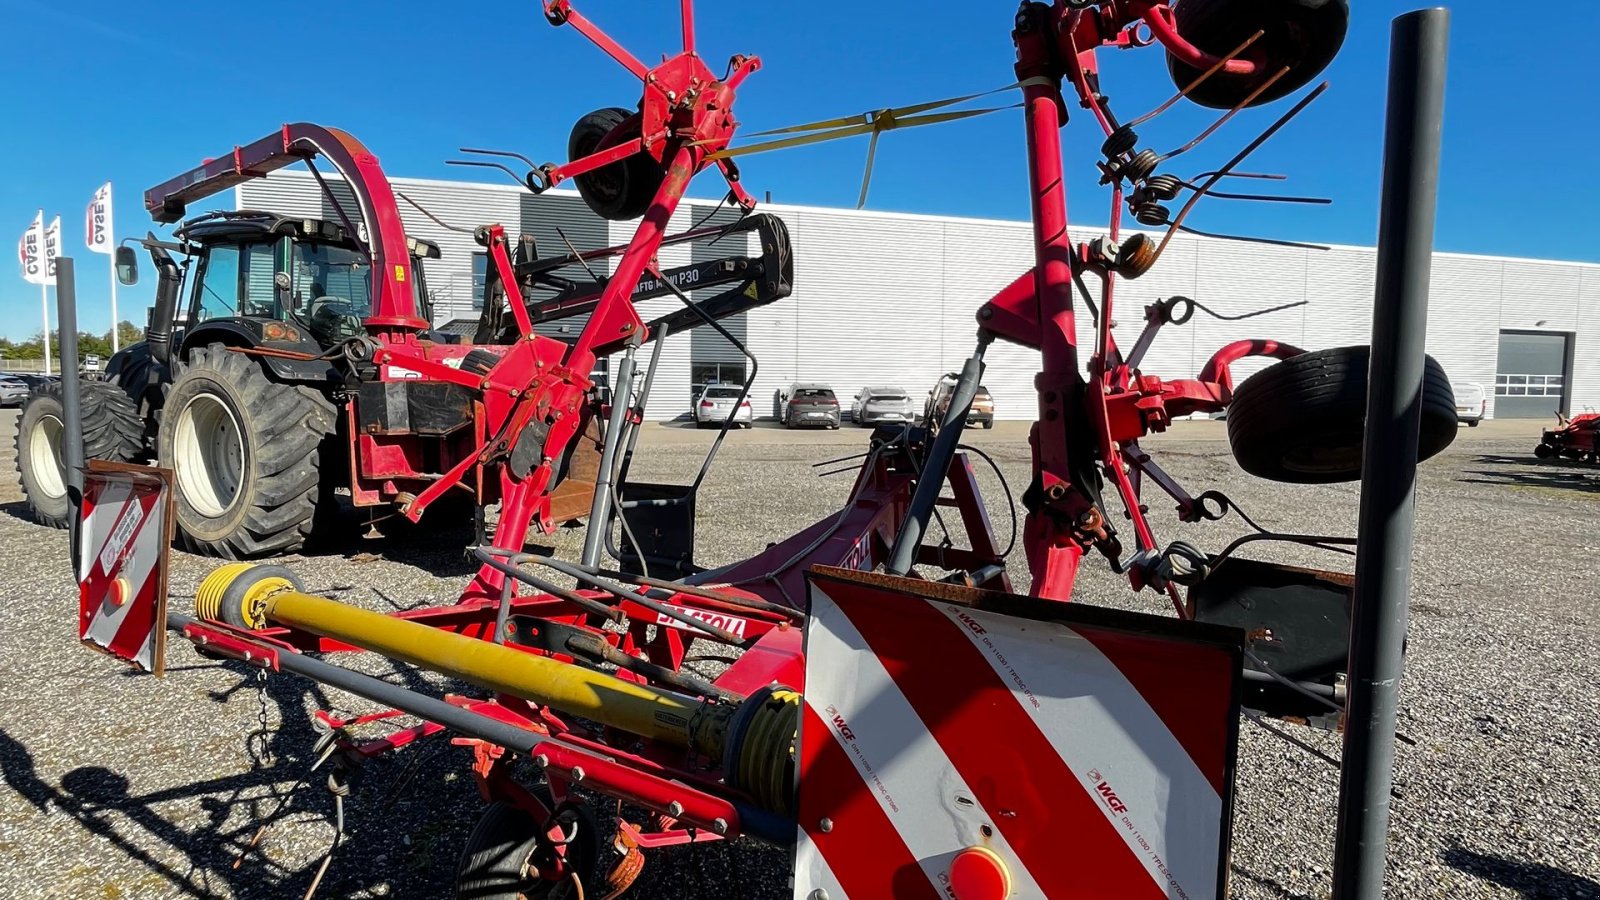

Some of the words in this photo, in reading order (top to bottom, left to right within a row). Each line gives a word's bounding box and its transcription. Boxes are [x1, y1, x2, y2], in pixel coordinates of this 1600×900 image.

[679, 268, 699, 285] P30
[959, 613, 987, 635] WGF
[982, 637, 994, 648] DIN
[992, 648, 1008, 666] 11030
[1009, 668, 1026, 691] TPESC
[833, 715, 856, 741] WGF
[851, 743, 860, 755] DIN
[1097, 782, 1128, 814] WGF
[1121, 816, 1134, 830] DIN
[1132, 829, 1150, 852] 11030
[1151, 854, 1173, 882] TPESC
